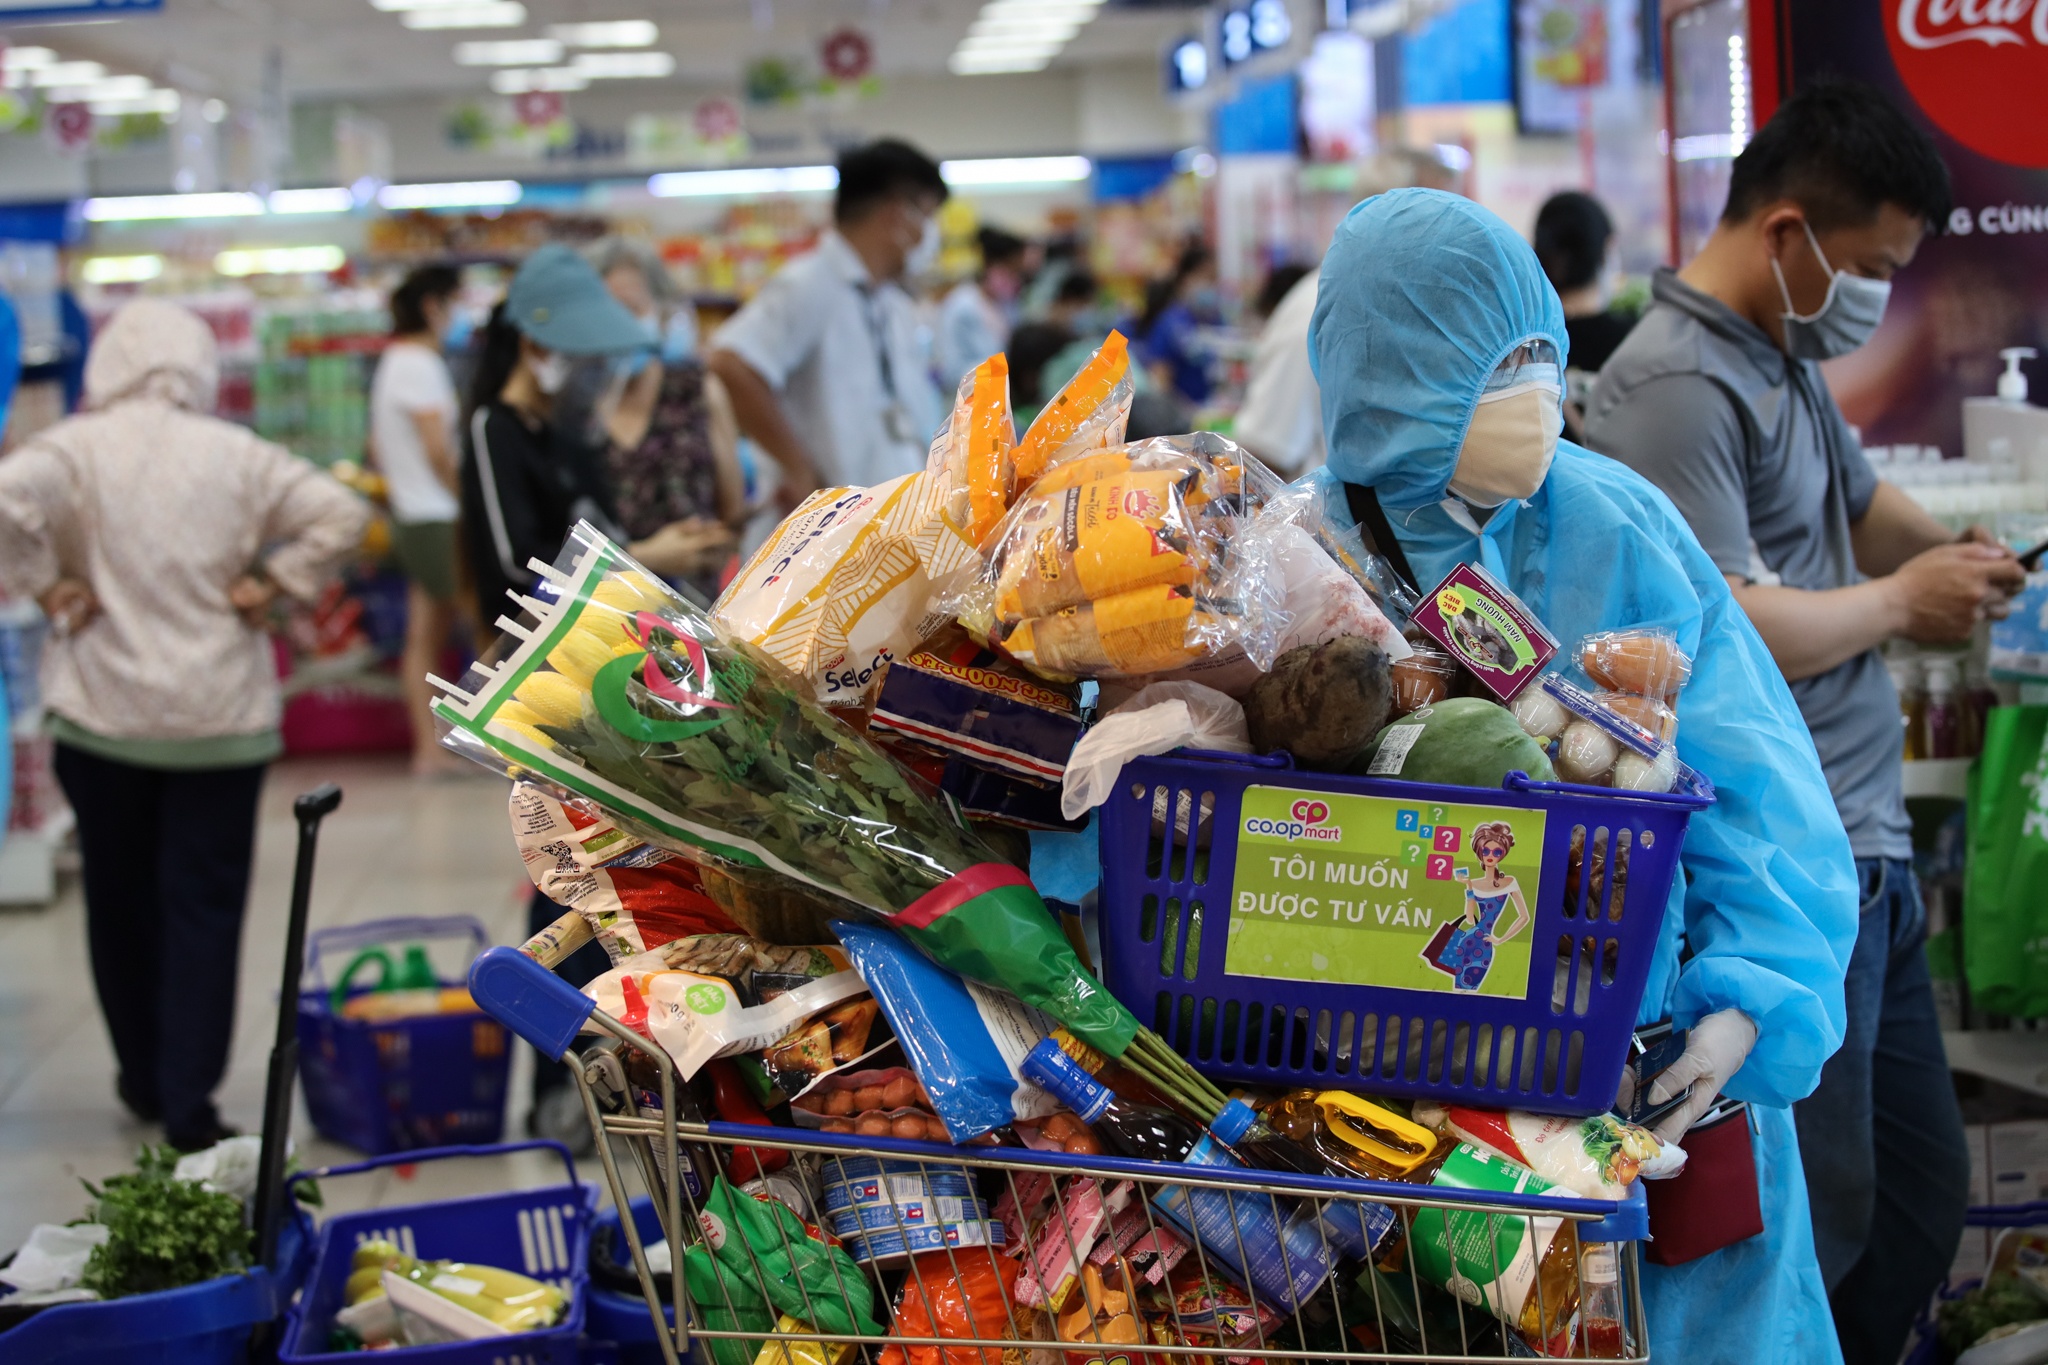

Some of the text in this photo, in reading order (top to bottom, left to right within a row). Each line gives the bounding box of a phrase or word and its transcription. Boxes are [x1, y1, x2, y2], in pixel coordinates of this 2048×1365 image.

[1107, 485, 1121, 506] KINH
[759, 493, 863, 589] Select
[1475, 597, 1507, 625] HƯƠNG
[825, 648, 894, 693] Select
[907, 651, 1073, 712] EGG NOODLES
[1269, 853, 1409, 889] TÔI MUỐN
[1238, 891, 1432, 928] ĐƯỢC TƯ VẤN
[709, 1231, 720, 1241] 1
